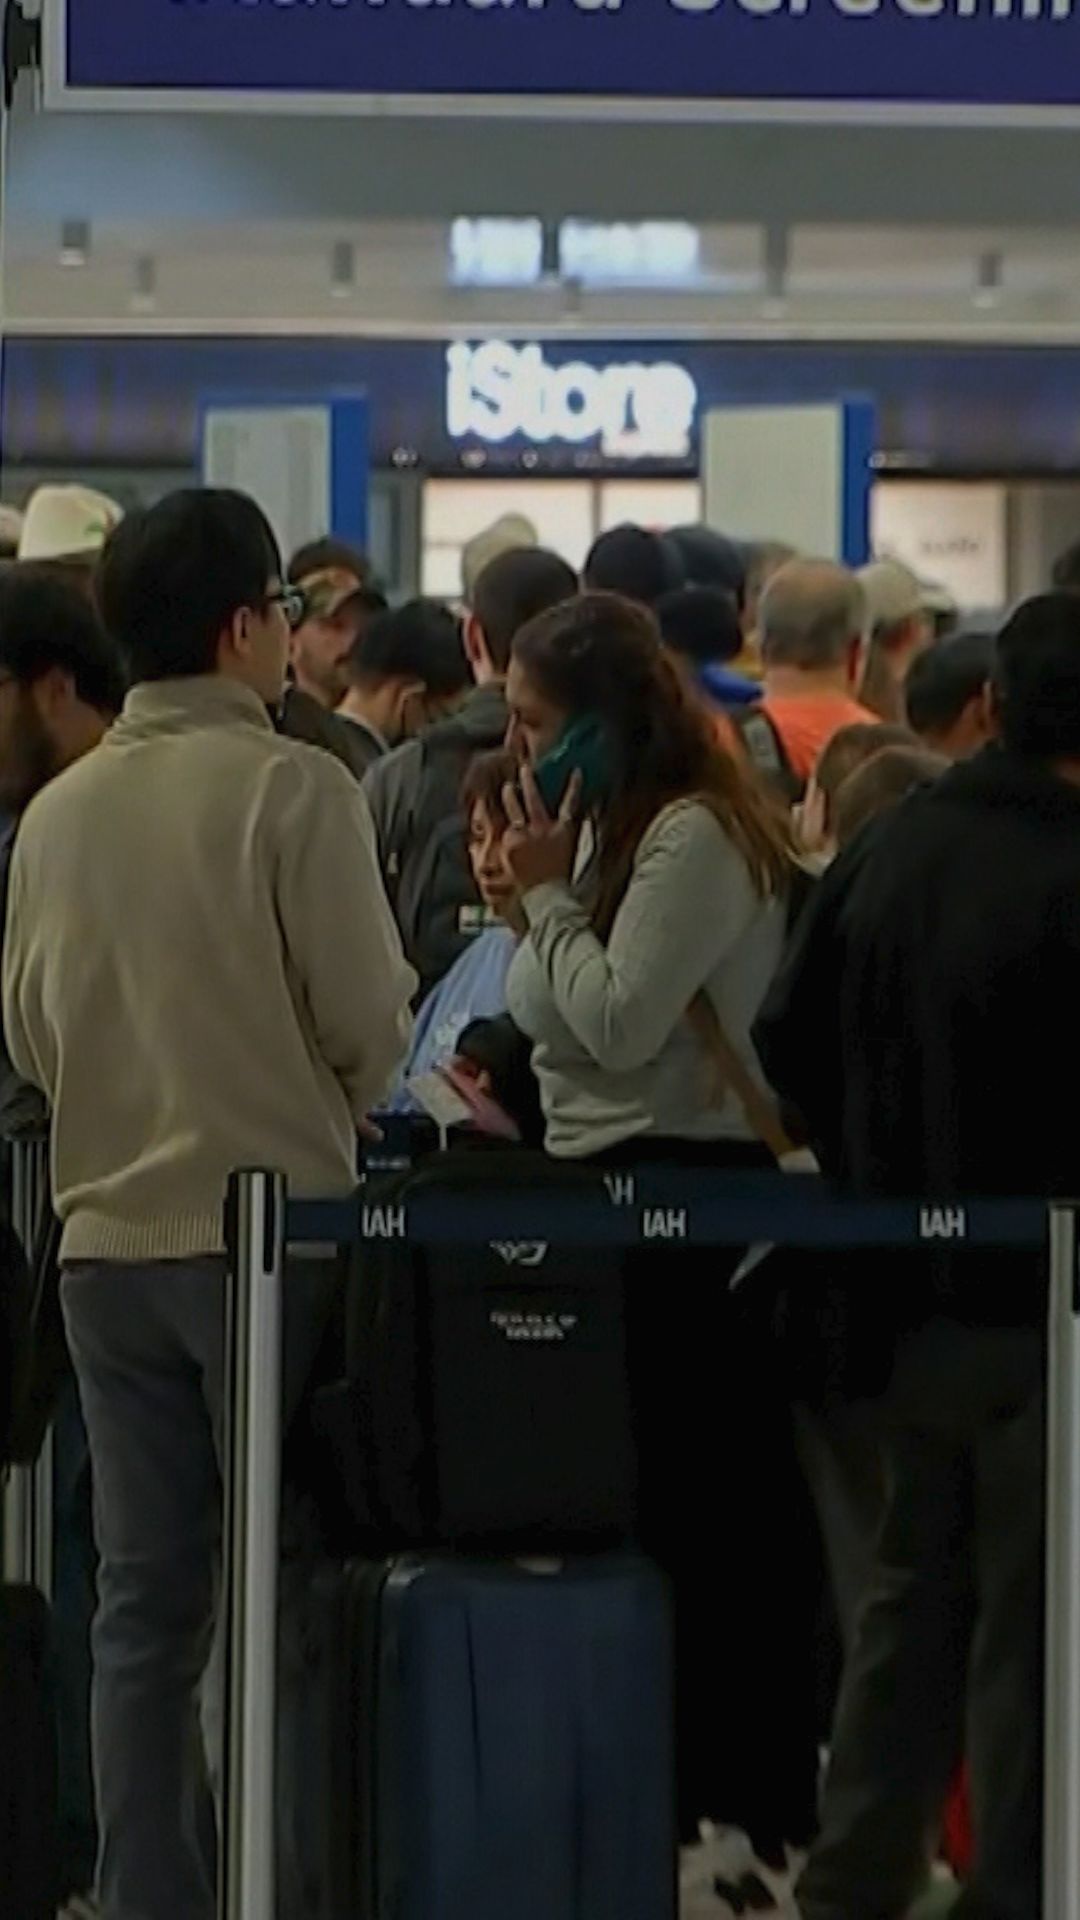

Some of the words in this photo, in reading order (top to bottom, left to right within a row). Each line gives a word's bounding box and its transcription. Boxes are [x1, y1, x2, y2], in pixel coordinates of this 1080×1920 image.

[362, 1205, 405, 1237] IAH
[643, 1208, 686, 1237] IAH
[921, 1208, 965, 1237] IAH
